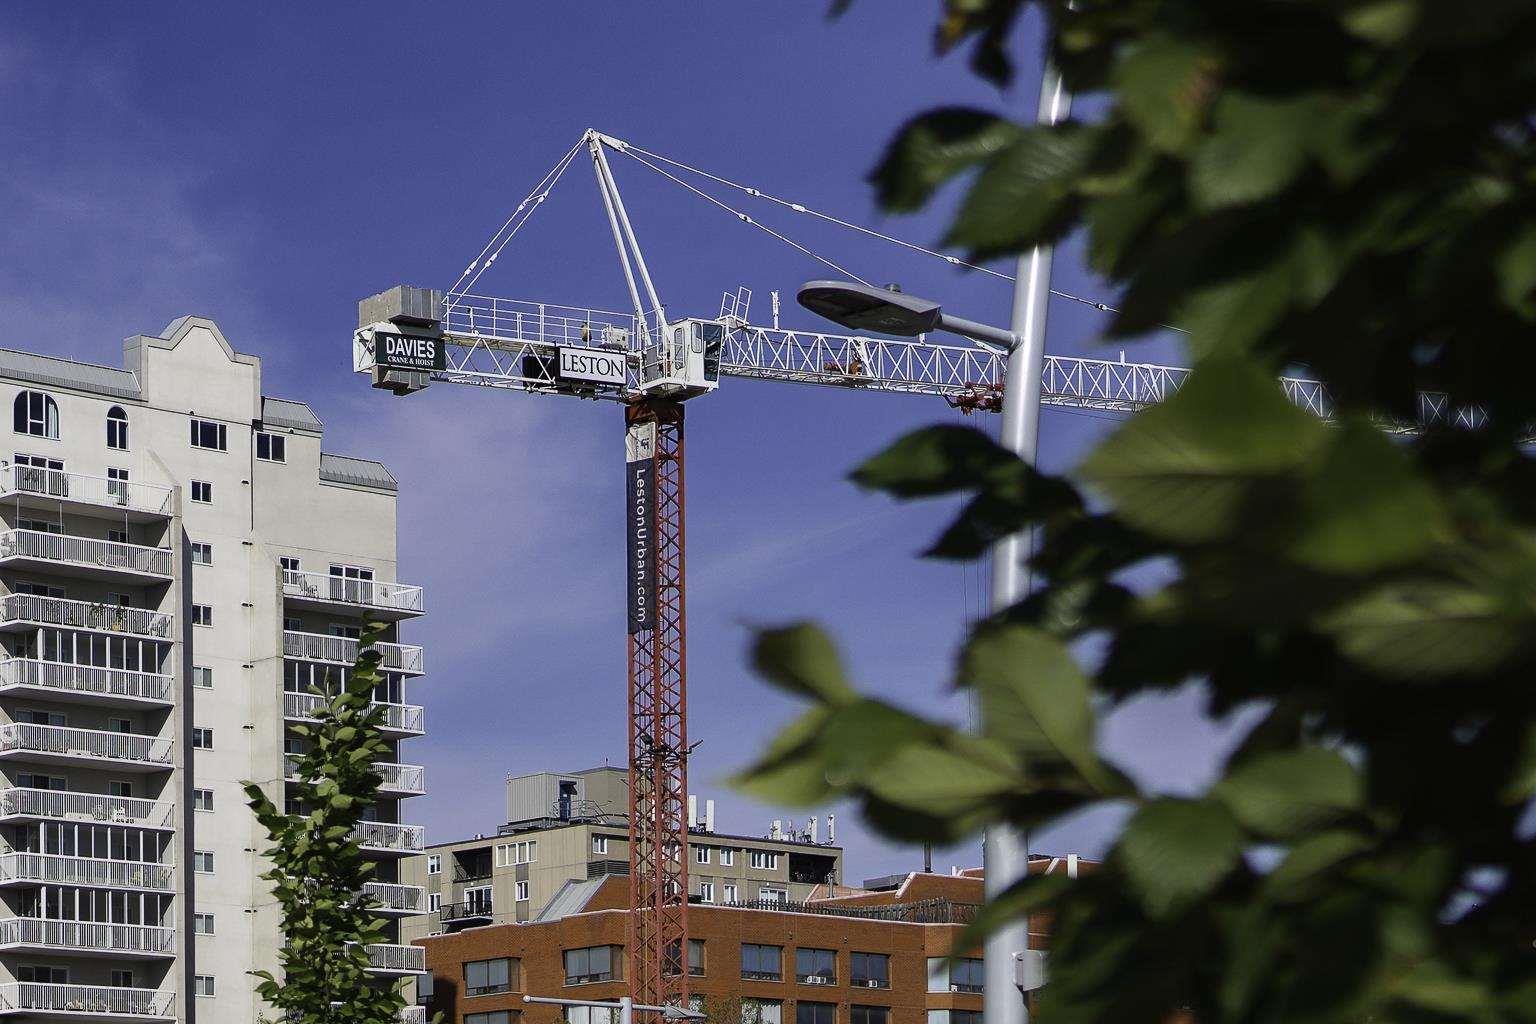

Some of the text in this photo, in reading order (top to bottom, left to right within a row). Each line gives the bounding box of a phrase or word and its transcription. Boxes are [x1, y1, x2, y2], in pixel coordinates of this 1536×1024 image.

[386, 336, 435, 359] DAVIES
[387, 356, 409, 365] CRANE
[415, 358, 434, 366] HOIST
[562, 353, 625, 377] LESTON
[636, 469, 647, 622] LestonUrban.com
